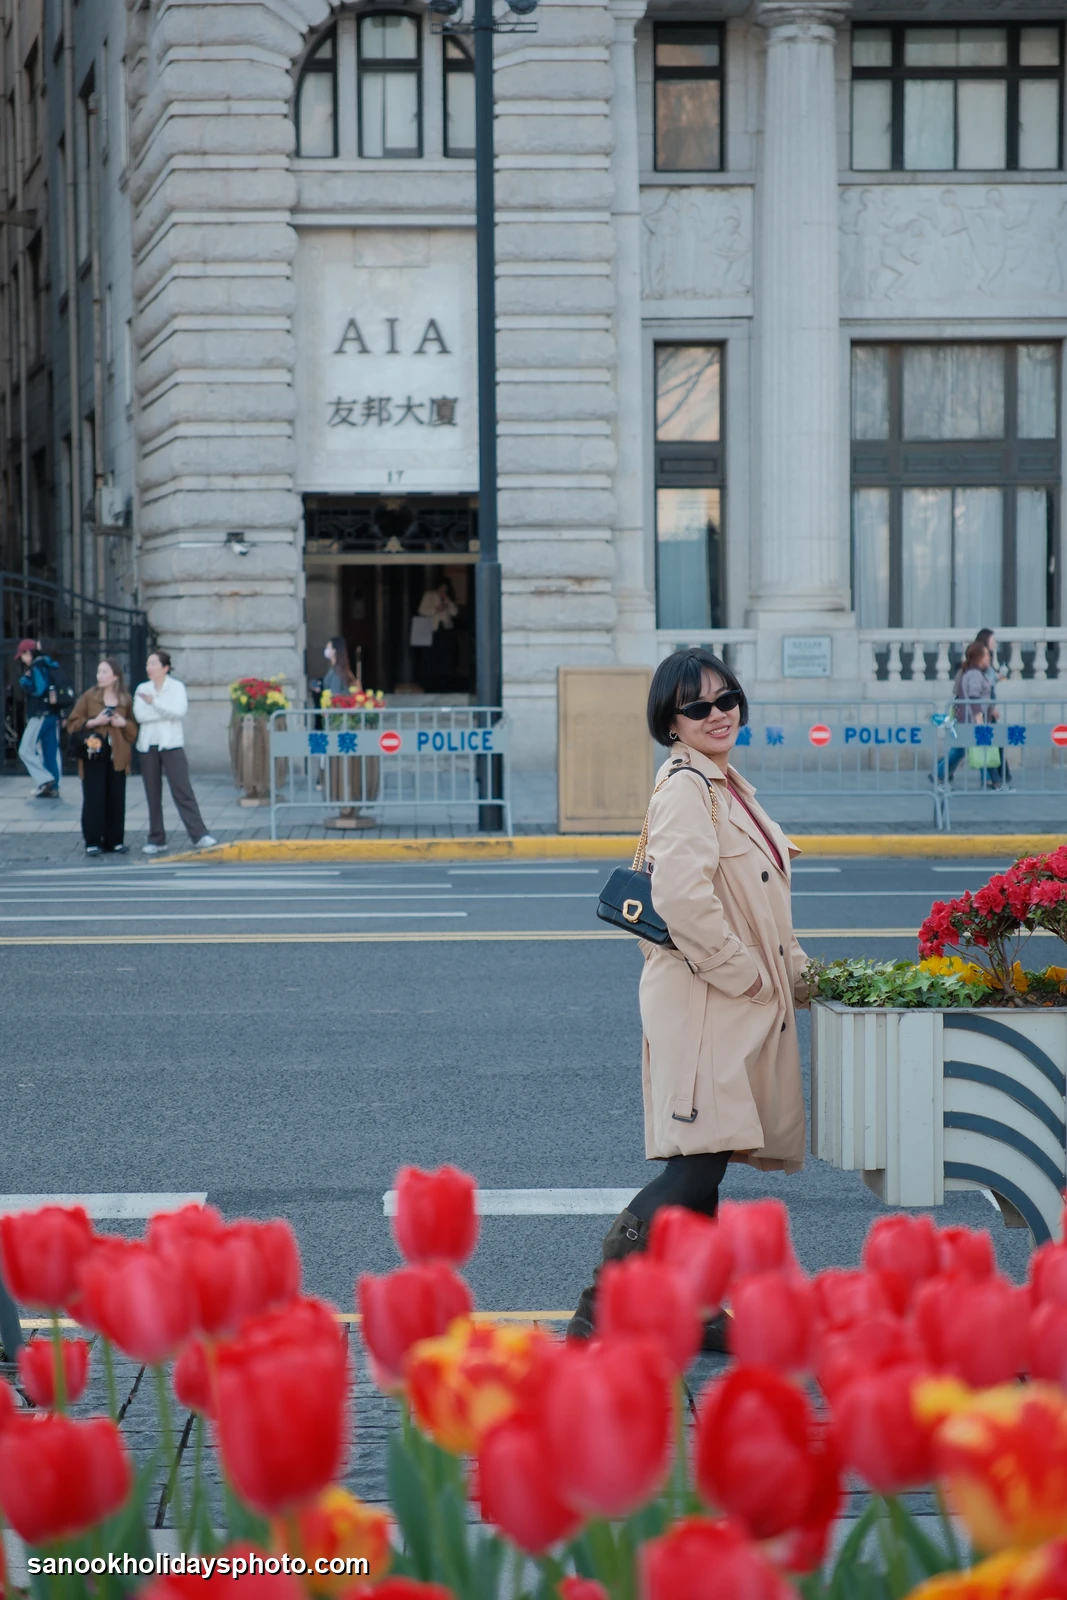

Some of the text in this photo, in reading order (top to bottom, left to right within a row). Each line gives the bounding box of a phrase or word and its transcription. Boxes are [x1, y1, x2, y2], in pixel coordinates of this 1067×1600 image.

[332, 317, 452, 355] AIA
[308, 730, 494, 755] 警察 POLICE
[844, 727, 922, 745] POLICE
